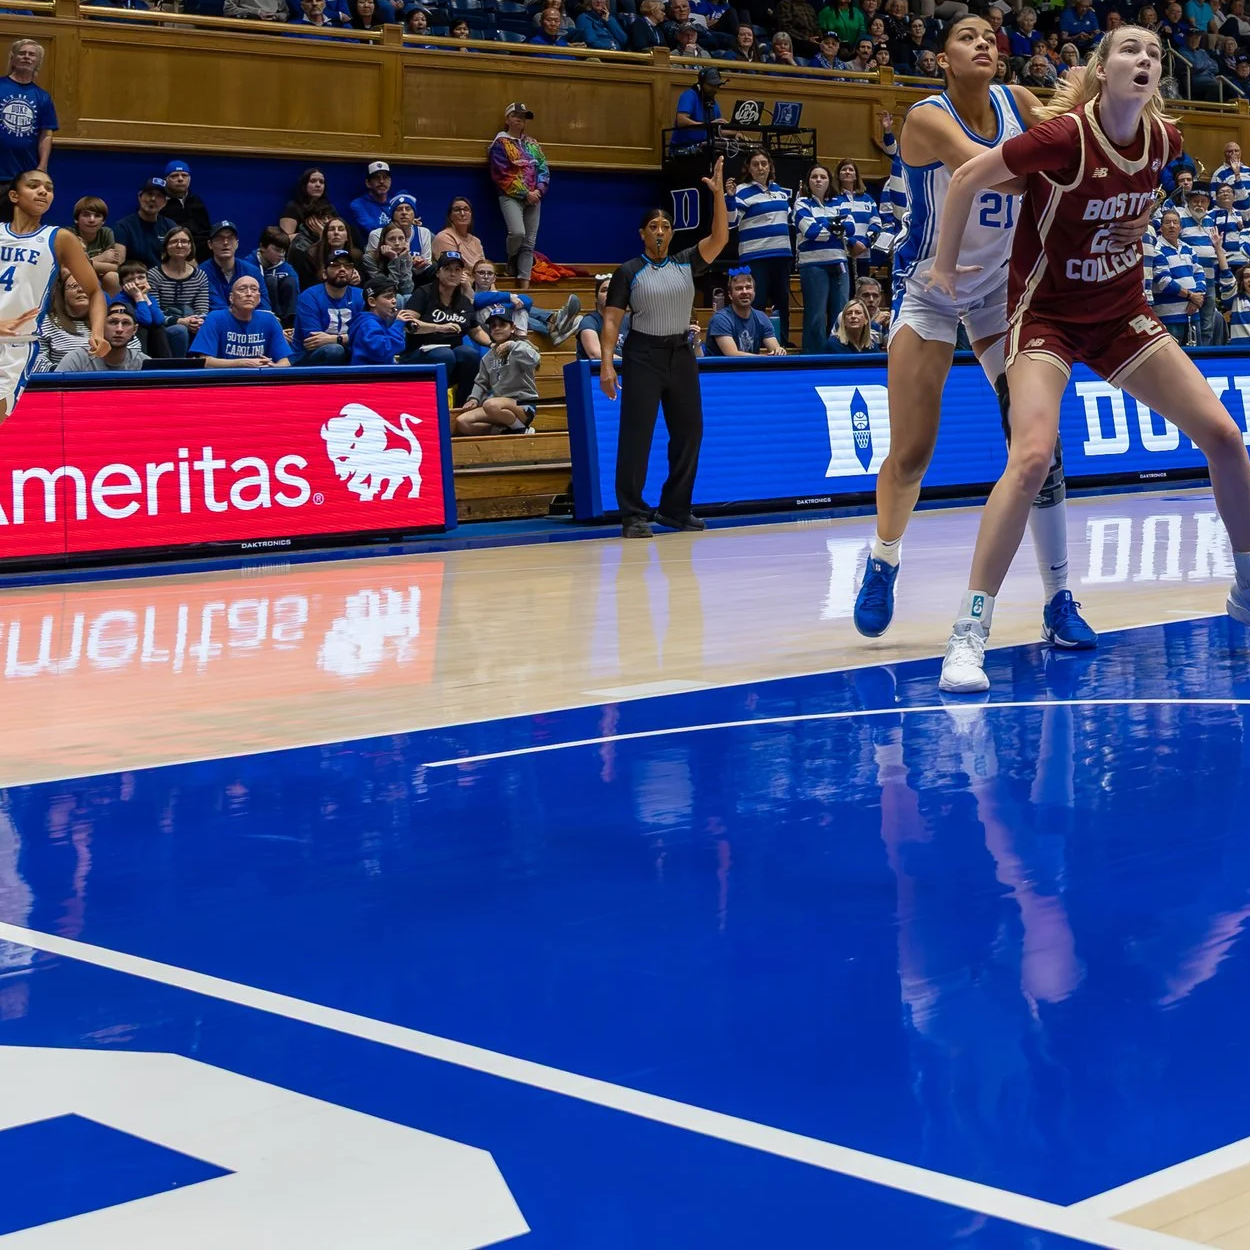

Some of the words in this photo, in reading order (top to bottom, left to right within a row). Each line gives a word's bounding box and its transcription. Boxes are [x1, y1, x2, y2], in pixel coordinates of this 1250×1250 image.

[979, 192, 1014, 229] 21
[432, 308, 466, 324] Duke
[0, 446, 312, 525] meritas
[796, 497, 832, 505] DAKTRONICS
[241, 540, 291, 549] DAKTRONICS
